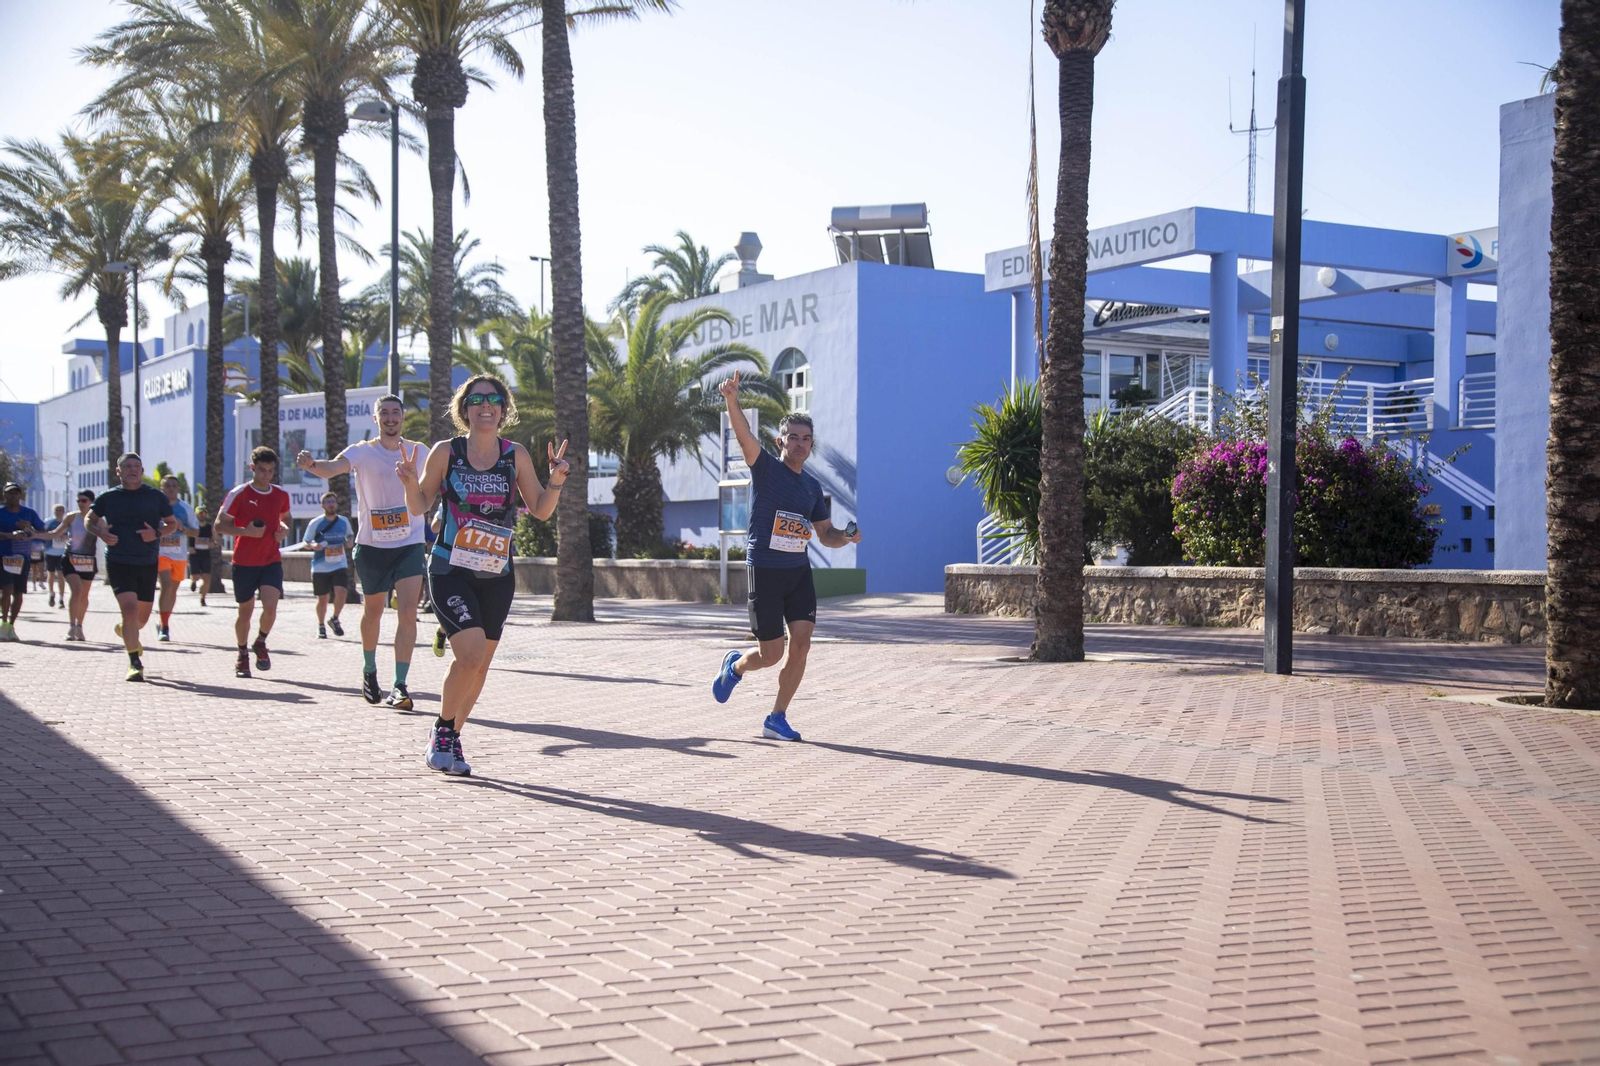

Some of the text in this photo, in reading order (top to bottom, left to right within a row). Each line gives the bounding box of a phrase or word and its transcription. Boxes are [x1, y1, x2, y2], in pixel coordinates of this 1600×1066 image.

[1087, 222, 1178, 260] NAUTICO
[730, 314, 753, 340] DE
[760, 293, 820, 334] MAR
[144, 367, 188, 400] CLUB DE MAR
[288, 409, 300, 420] DE
[303, 406, 325, 419] MAR
[292, 493, 303, 504] TU
[379, 513, 402, 525] 185
[778, 519, 810, 536] 2628
[463, 528, 506, 552] 1775
